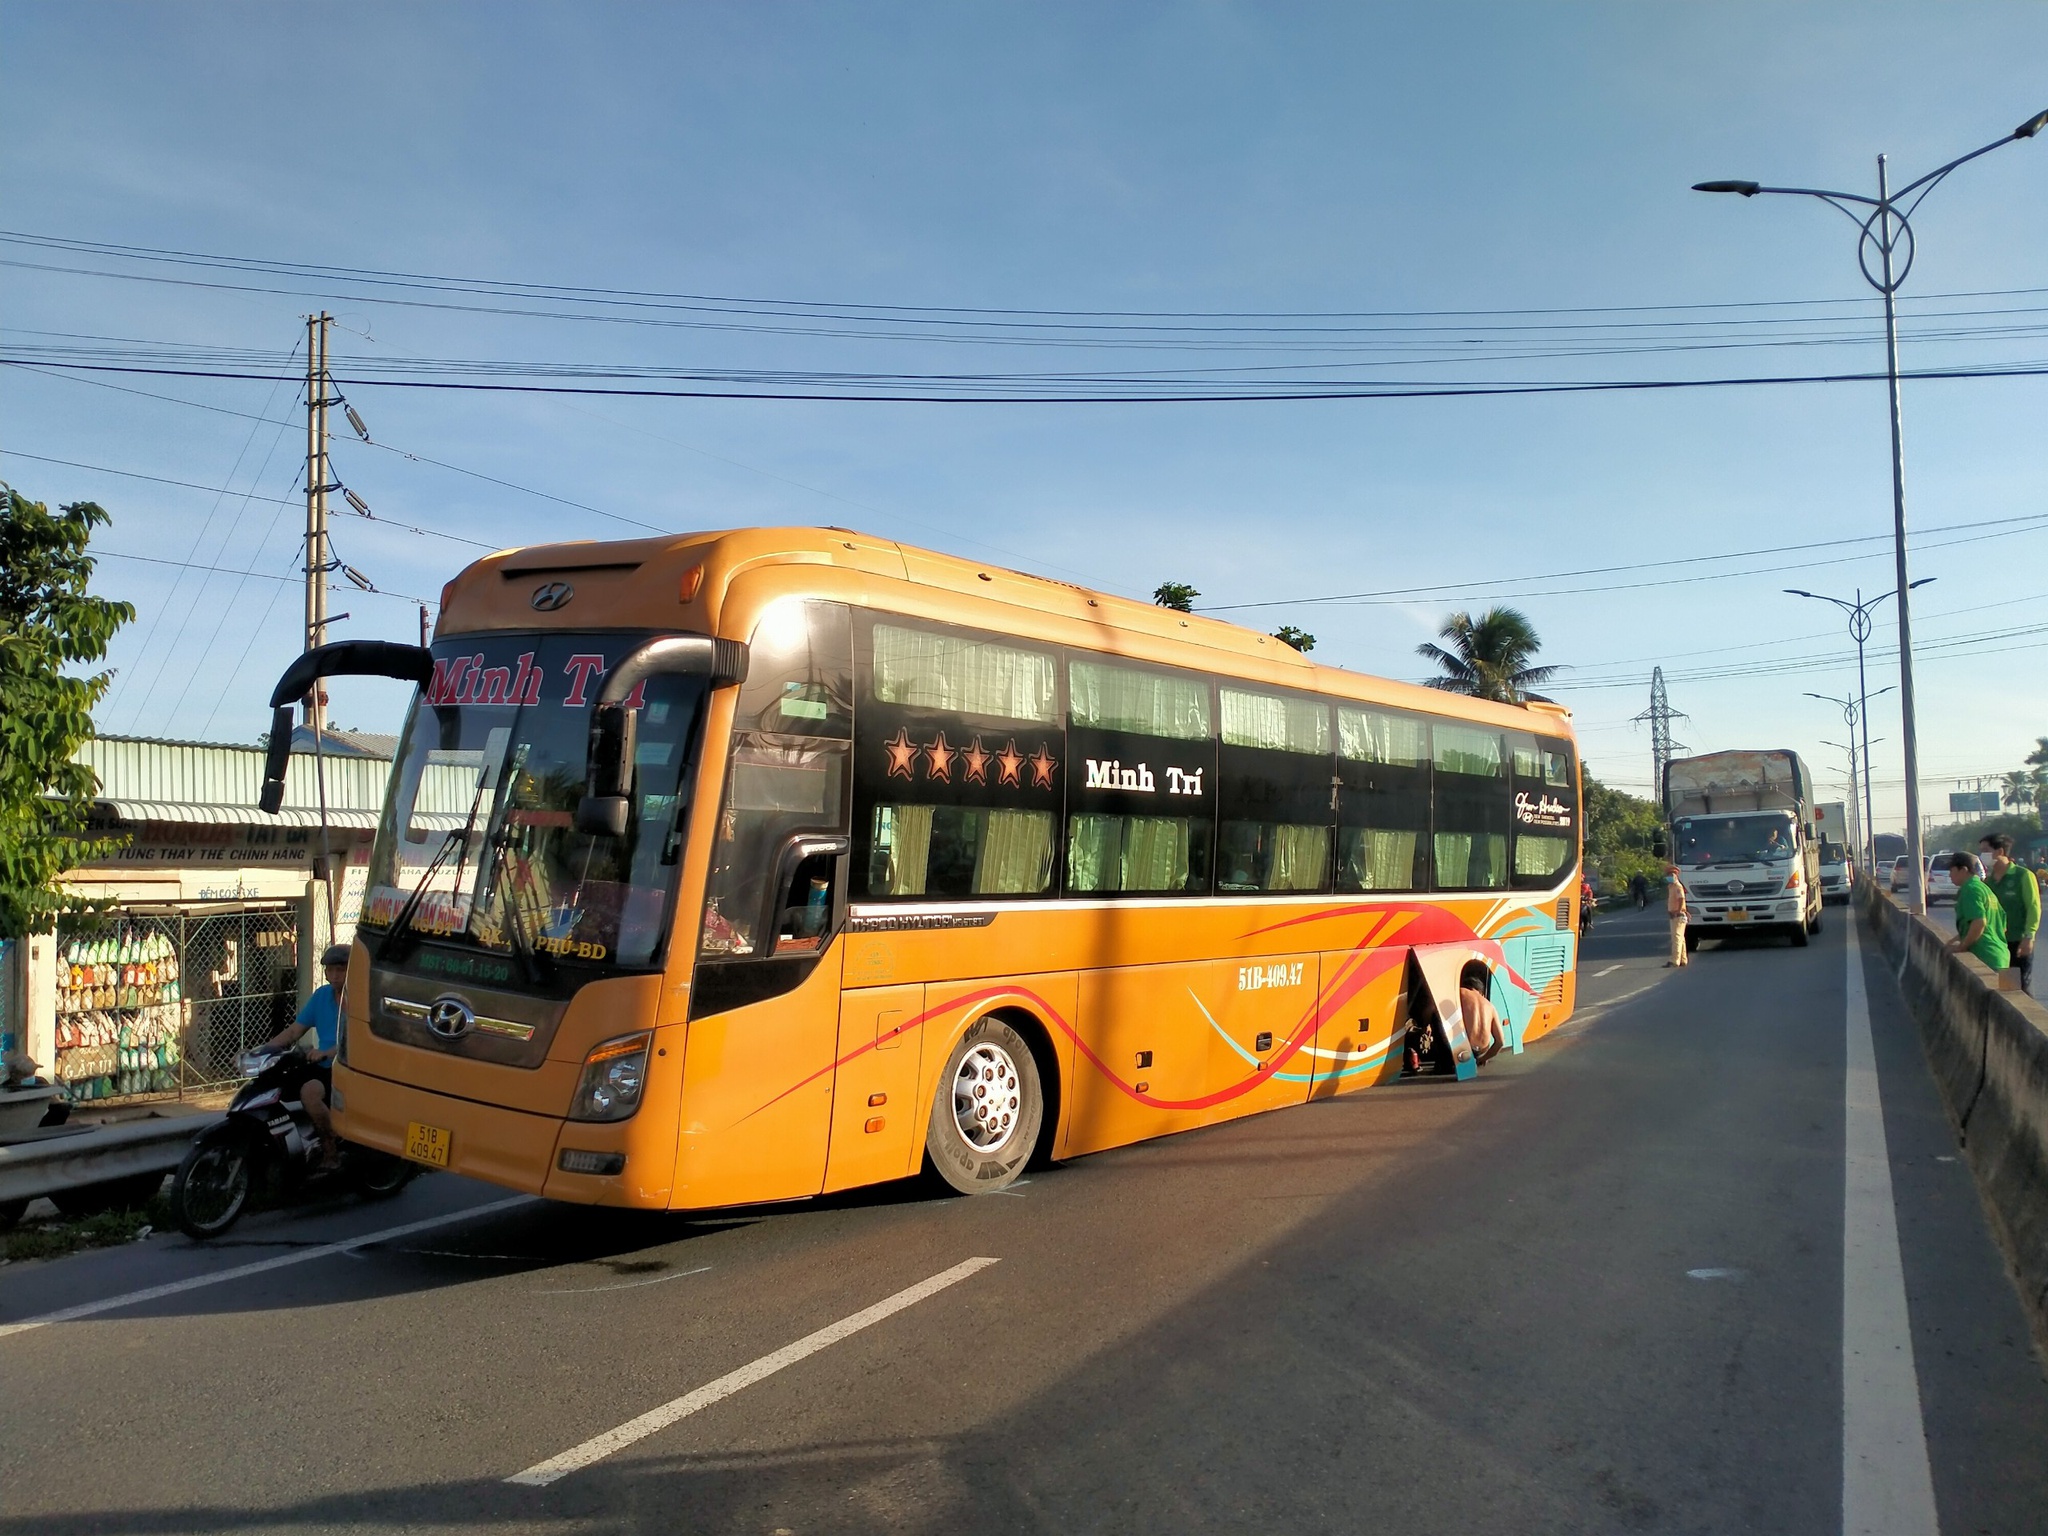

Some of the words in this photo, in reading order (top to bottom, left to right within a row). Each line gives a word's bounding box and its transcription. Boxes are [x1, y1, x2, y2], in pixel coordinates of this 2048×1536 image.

[421, 651, 544, 707] Minh
[1085, 759, 1155, 793] Minh
[1166, 766, 1204, 795] Trí
[160, 848, 196, 860] THAY
[1238, 962, 1304, 991] 51B-409.47
[419, 1125, 438, 1144] 51B
[410, 1141, 443, 1163] 409.47
